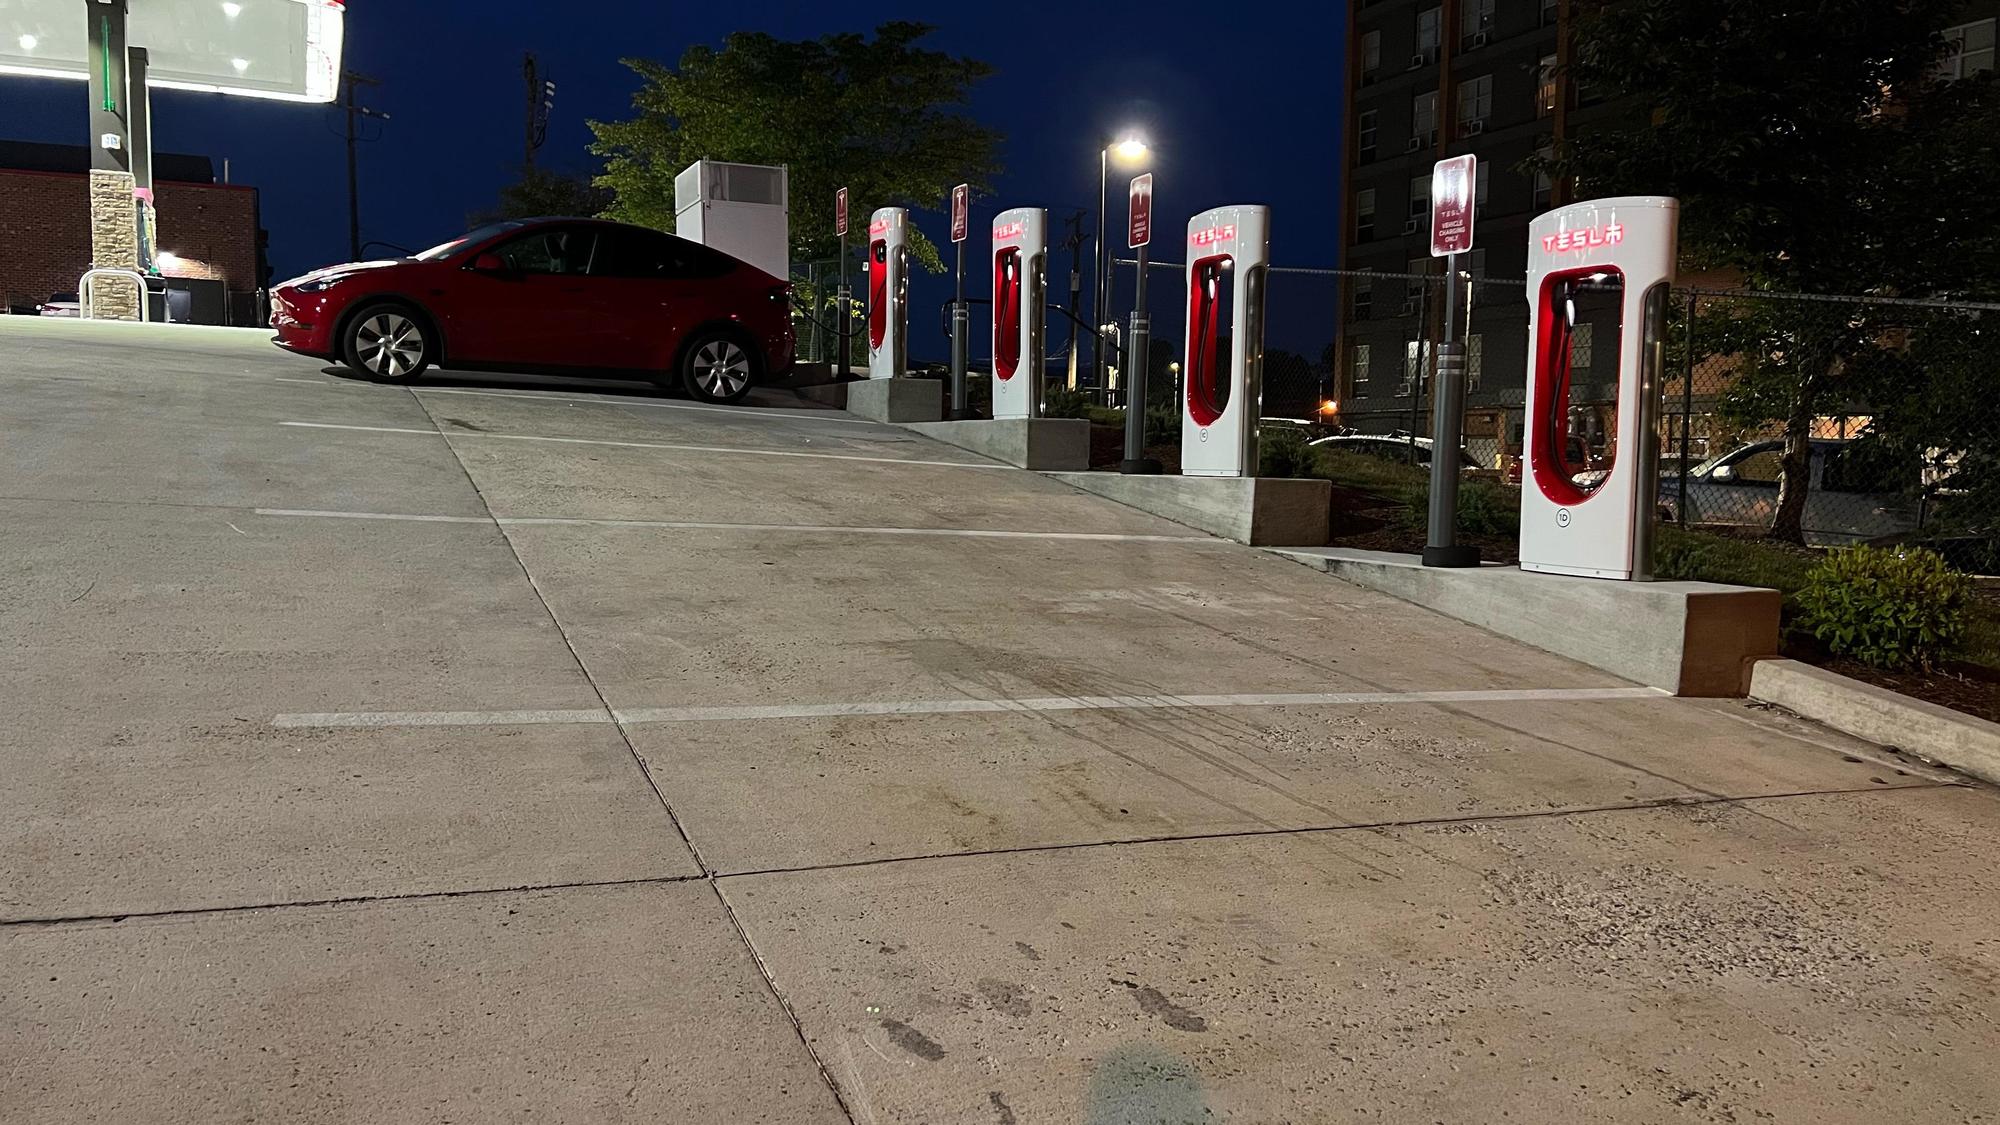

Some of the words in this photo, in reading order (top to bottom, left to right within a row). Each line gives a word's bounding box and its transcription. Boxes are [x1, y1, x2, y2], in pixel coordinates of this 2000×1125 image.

[1442, 220, 1463, 229] VEHICLE
[1192, 225, 1234, 245] TESLA
[1439, 227, 1465, 237] CHARGING
[1445, 235, 1459, 243] ONLY
[1543, 225, 1622, 251] TESLA
